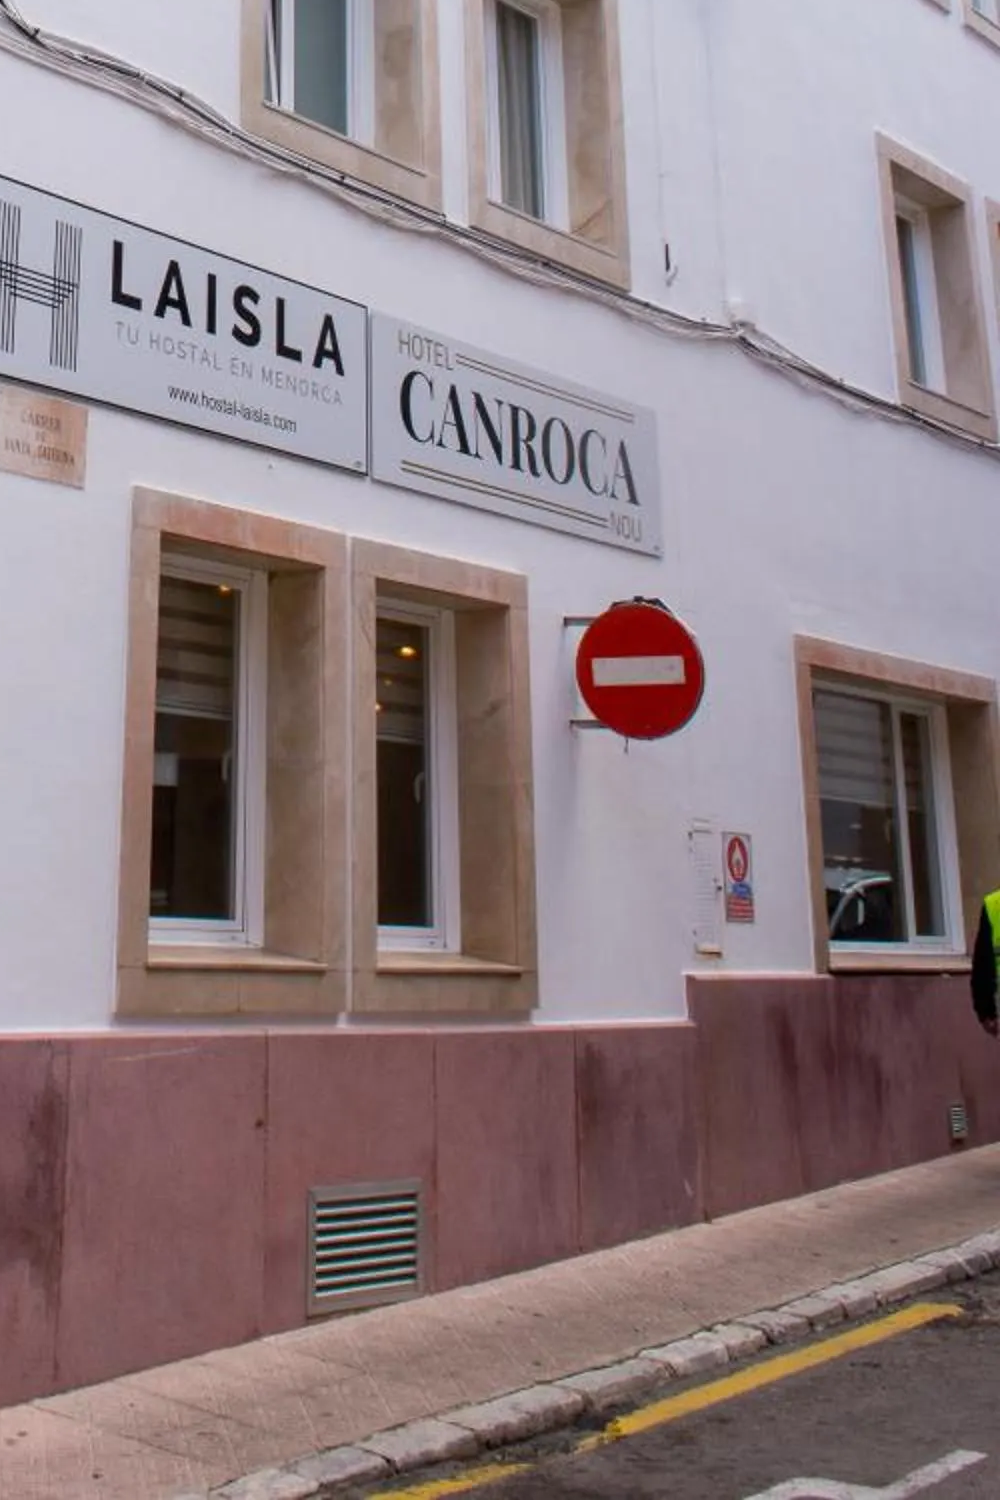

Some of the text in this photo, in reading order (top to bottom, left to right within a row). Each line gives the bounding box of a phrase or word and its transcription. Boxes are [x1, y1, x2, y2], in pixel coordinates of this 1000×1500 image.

[115, 320, 343, 406] TU HOSTAL EN MENORCA
[397, 329, 454, 371] HOTEL
[167, 384, 298, 434] www.hostal-laisla.com
[400, 369, 641, 507] CANROCA
[610, 510, 643, 543] NOU
